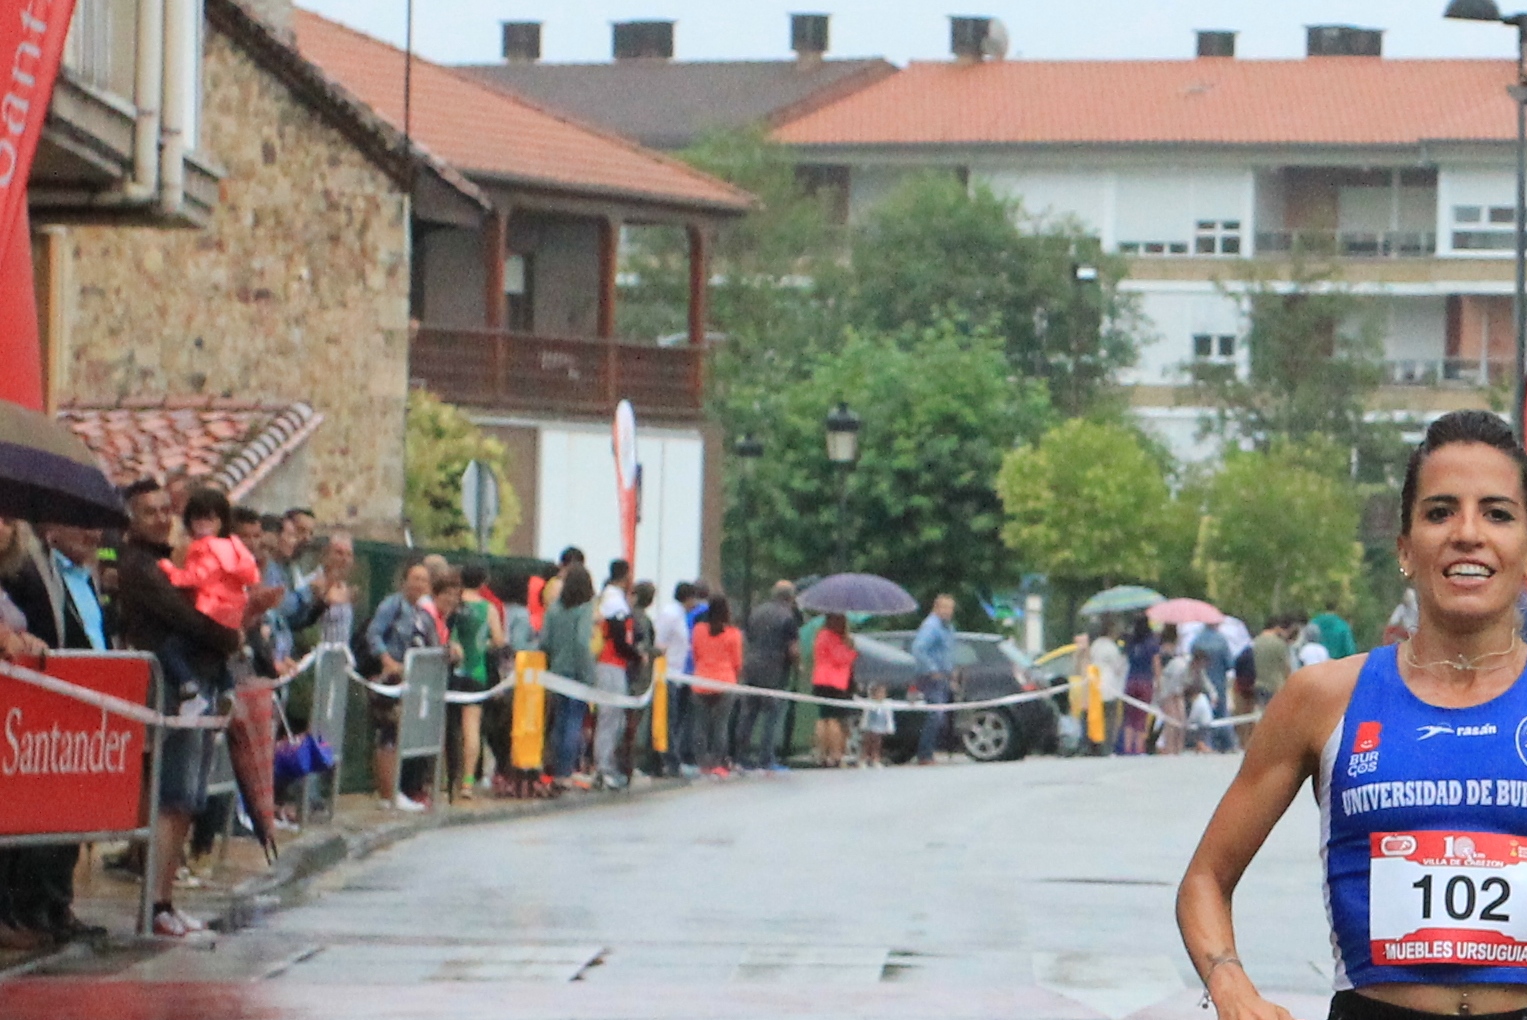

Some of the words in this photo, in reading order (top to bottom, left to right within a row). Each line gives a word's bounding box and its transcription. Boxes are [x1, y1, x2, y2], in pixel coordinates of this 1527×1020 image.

[2, 705, 132, 776] Santander
[1349, 751, 1379, 766] BUR
[1347, 762, 1378, 778] GOS
[1341, 779, 1462, 816] UNIVERSIDAD
[1466, 779, 1492, 806] DE
[1422, 858, 1447, 866] VILLA
[1450, 858, 1460, 866] DE
[1412, 873, 1511, 922] 102
[1384, 940, 1451, 961] MUEBLES
